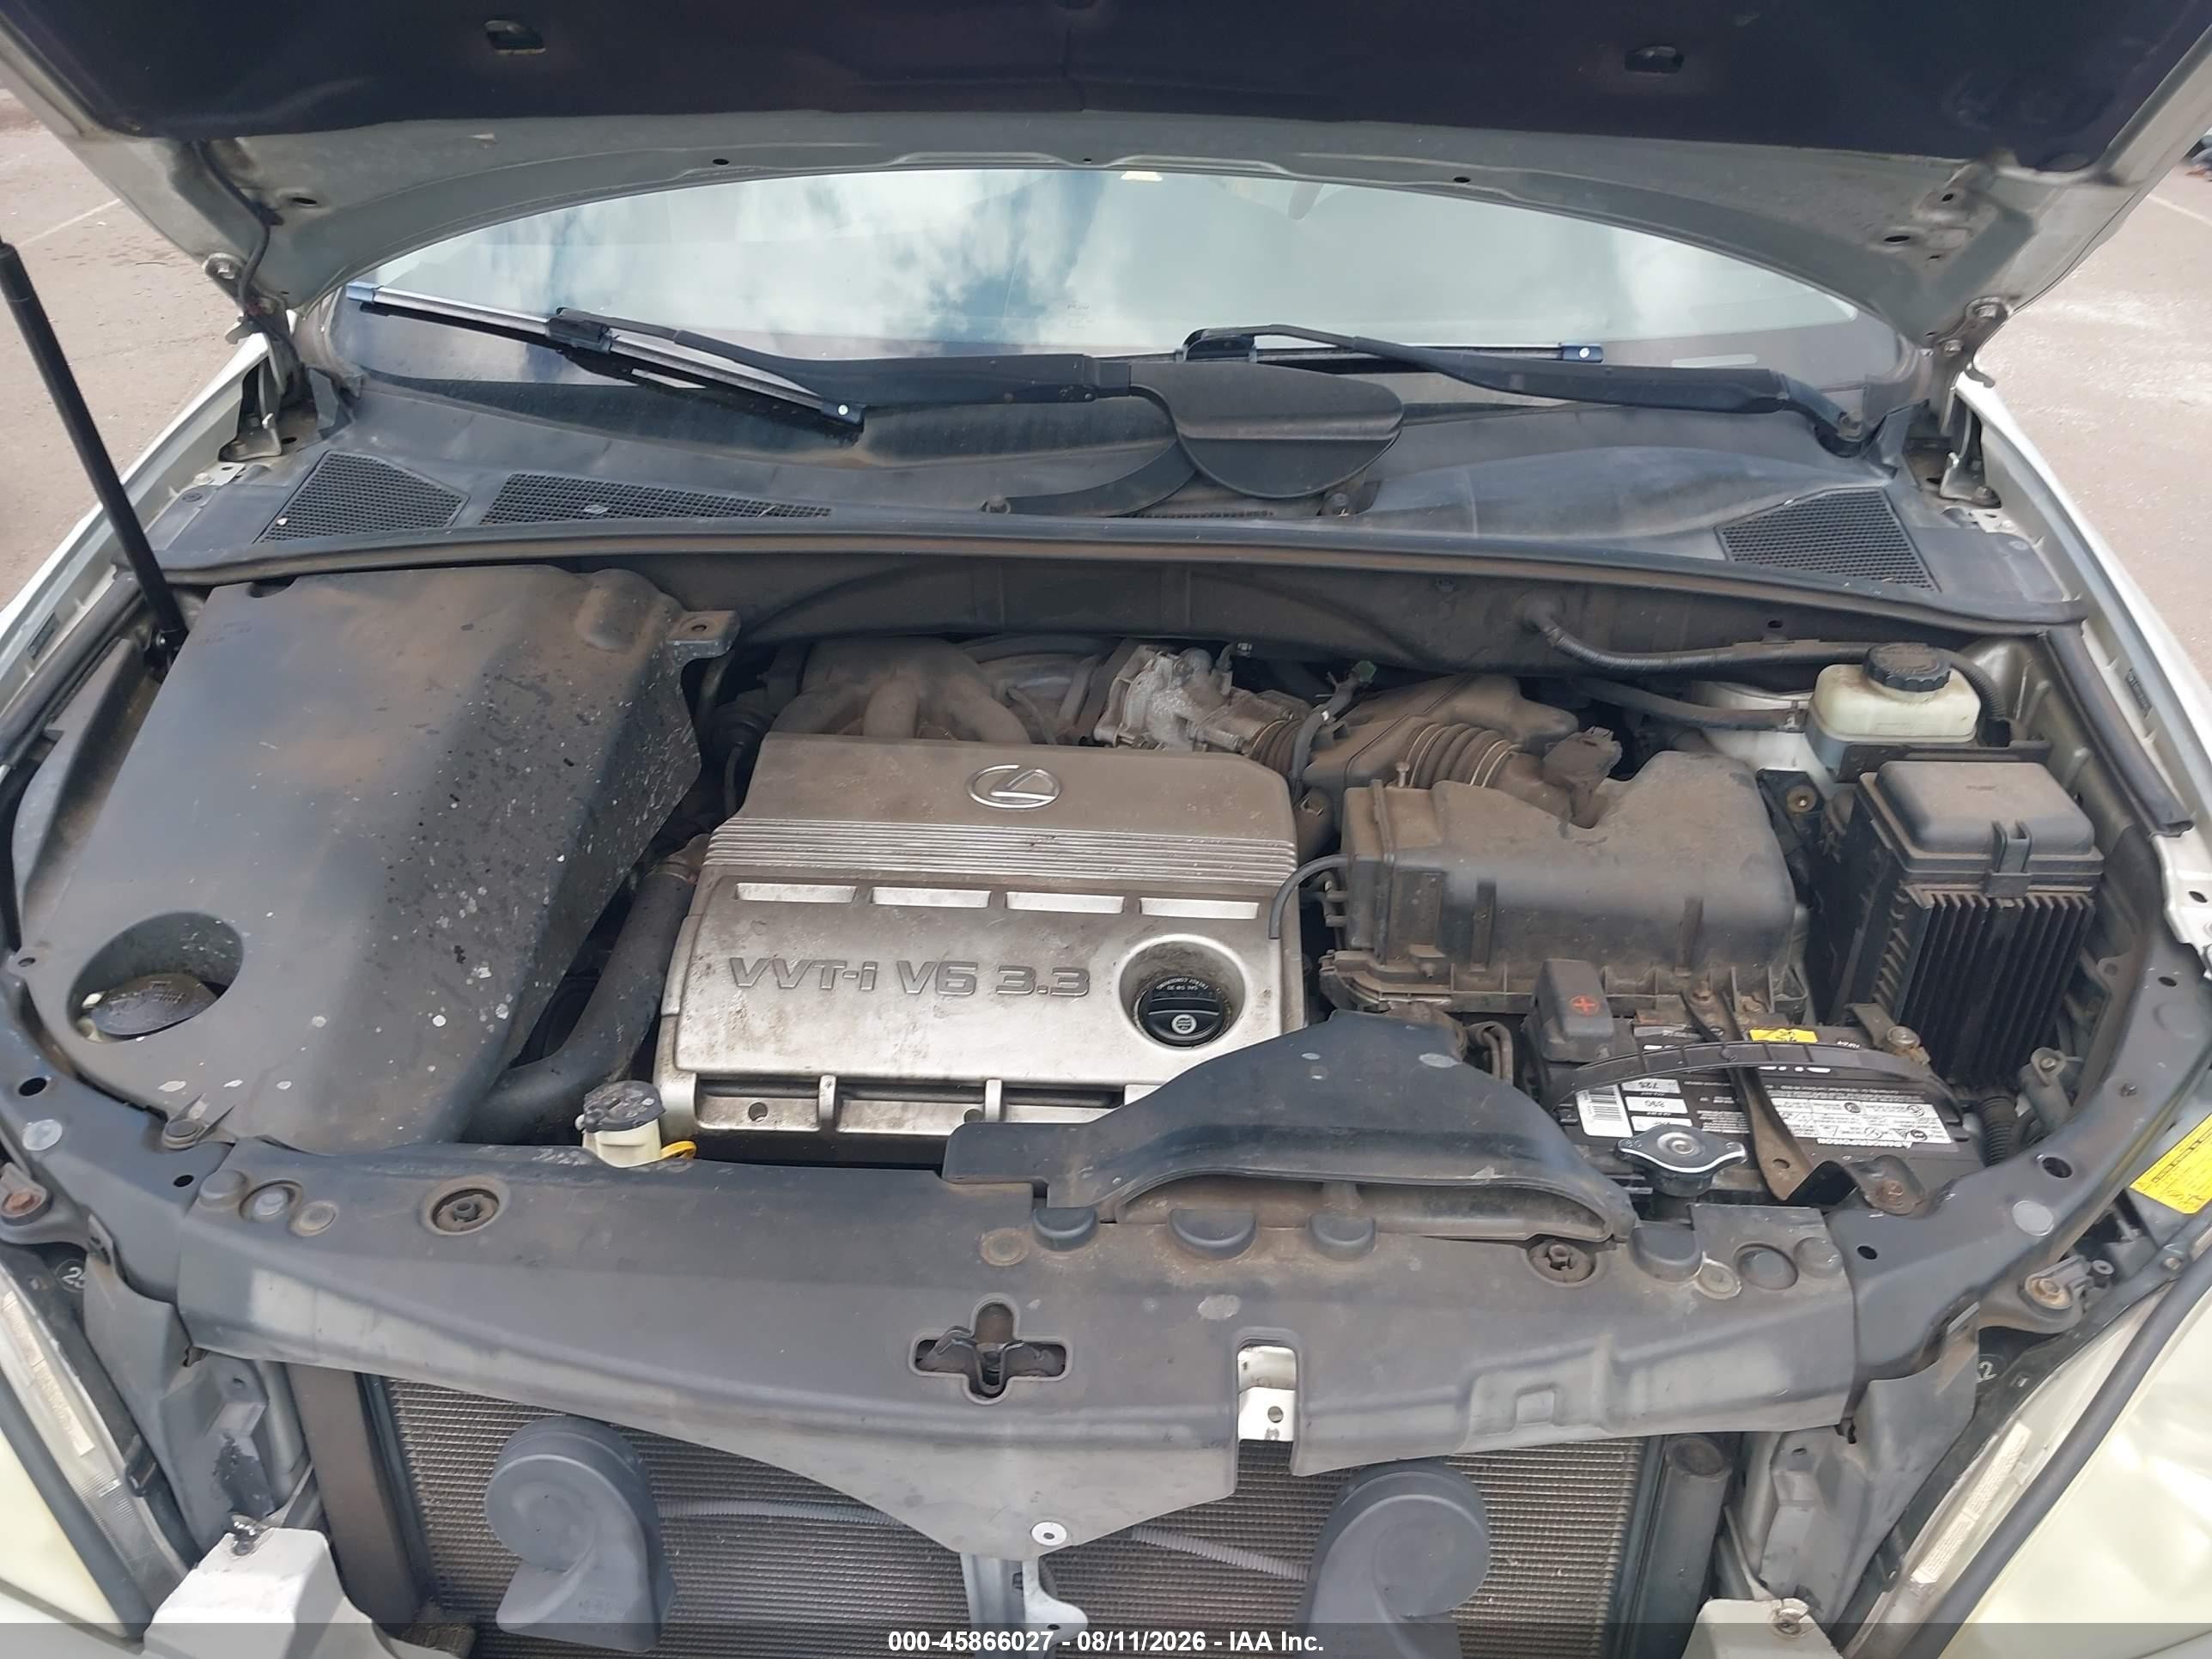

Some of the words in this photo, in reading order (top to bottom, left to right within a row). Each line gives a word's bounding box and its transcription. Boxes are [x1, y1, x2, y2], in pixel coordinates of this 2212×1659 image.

[729, 957, 878, 990] VVT-i
[896, 960, 978, 996] V6
[995, 965, 1091, 998] 3.3
